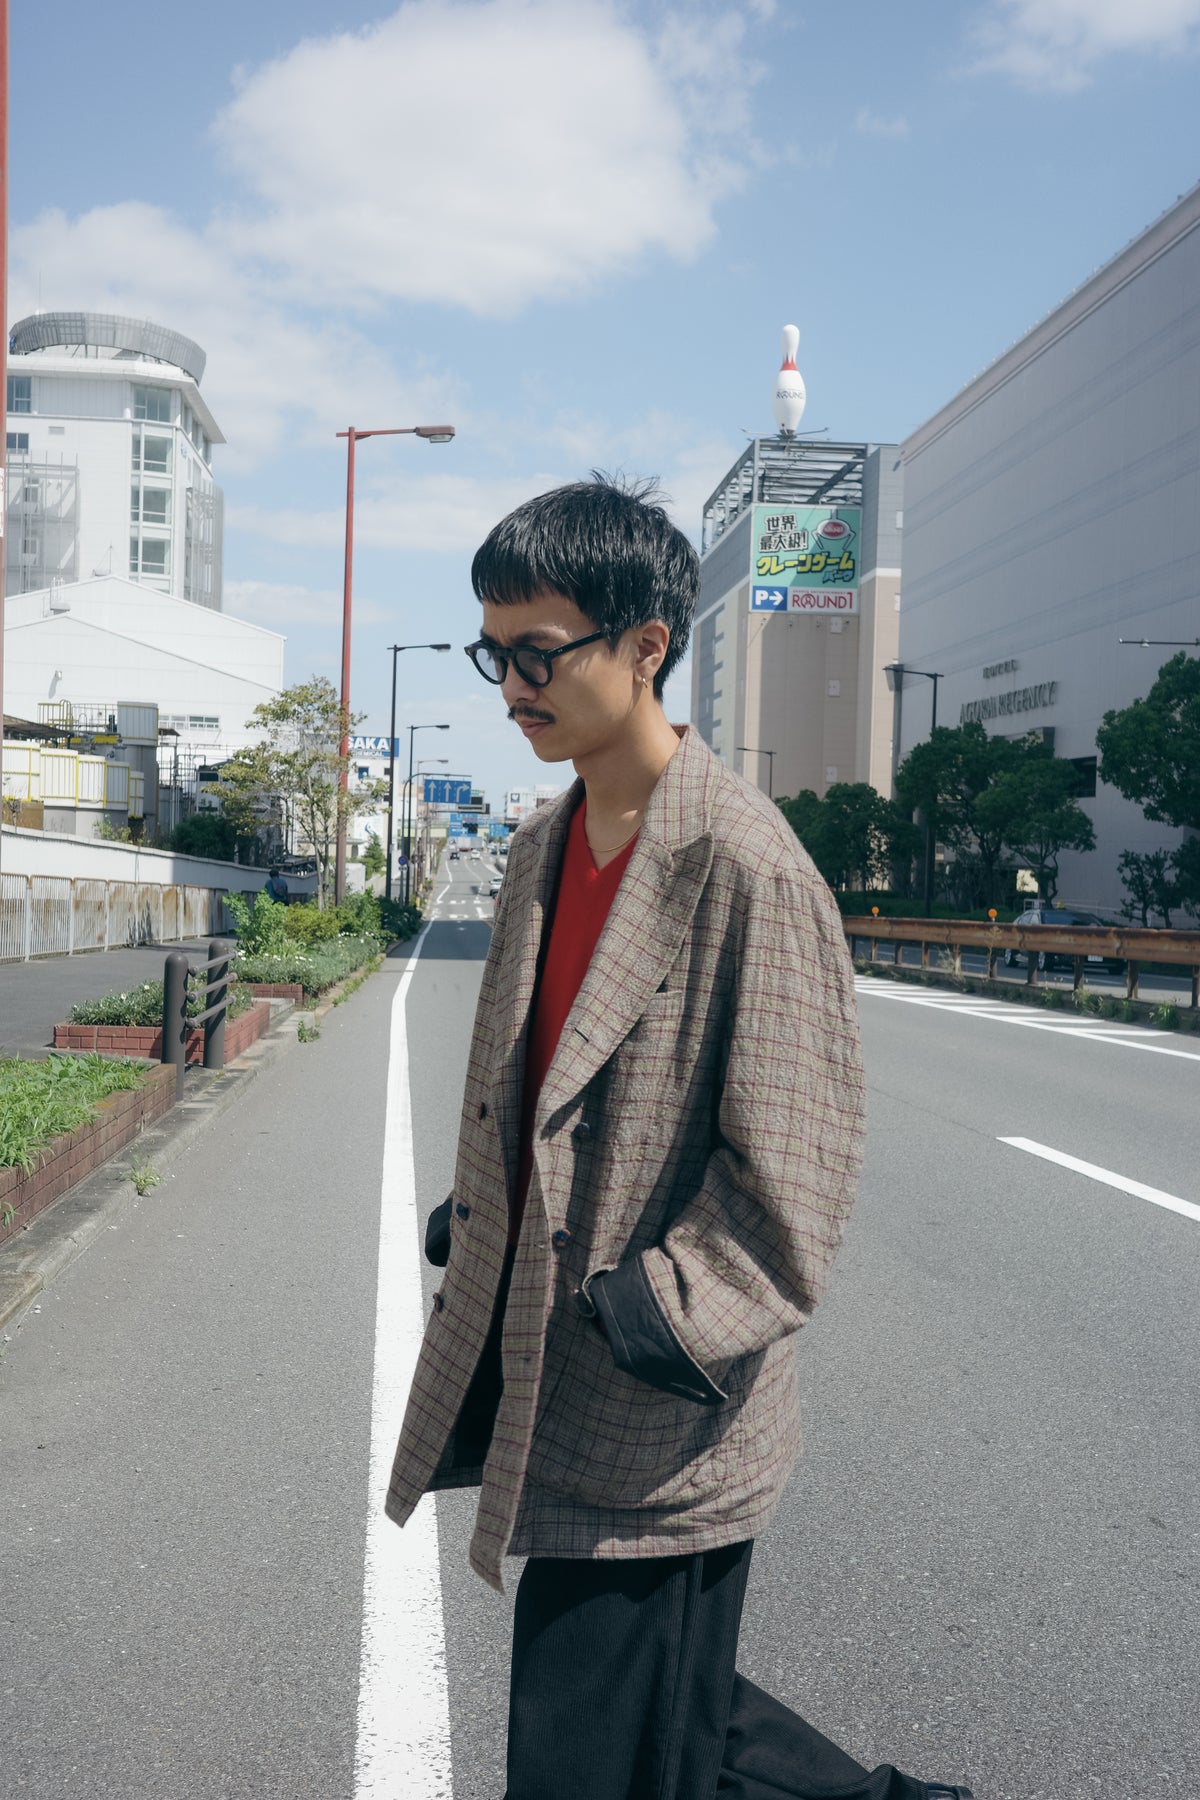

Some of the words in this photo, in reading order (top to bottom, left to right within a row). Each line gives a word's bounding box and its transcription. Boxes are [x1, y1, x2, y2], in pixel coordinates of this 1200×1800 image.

[766, 514, 796, 532] 世界
[757, 552, 854, 576] クレーンゲーム
[755, 589, 769, 606] P
[792, 591, 853, 609] ROUND1
[347, 736, 391, 750] SAKA
